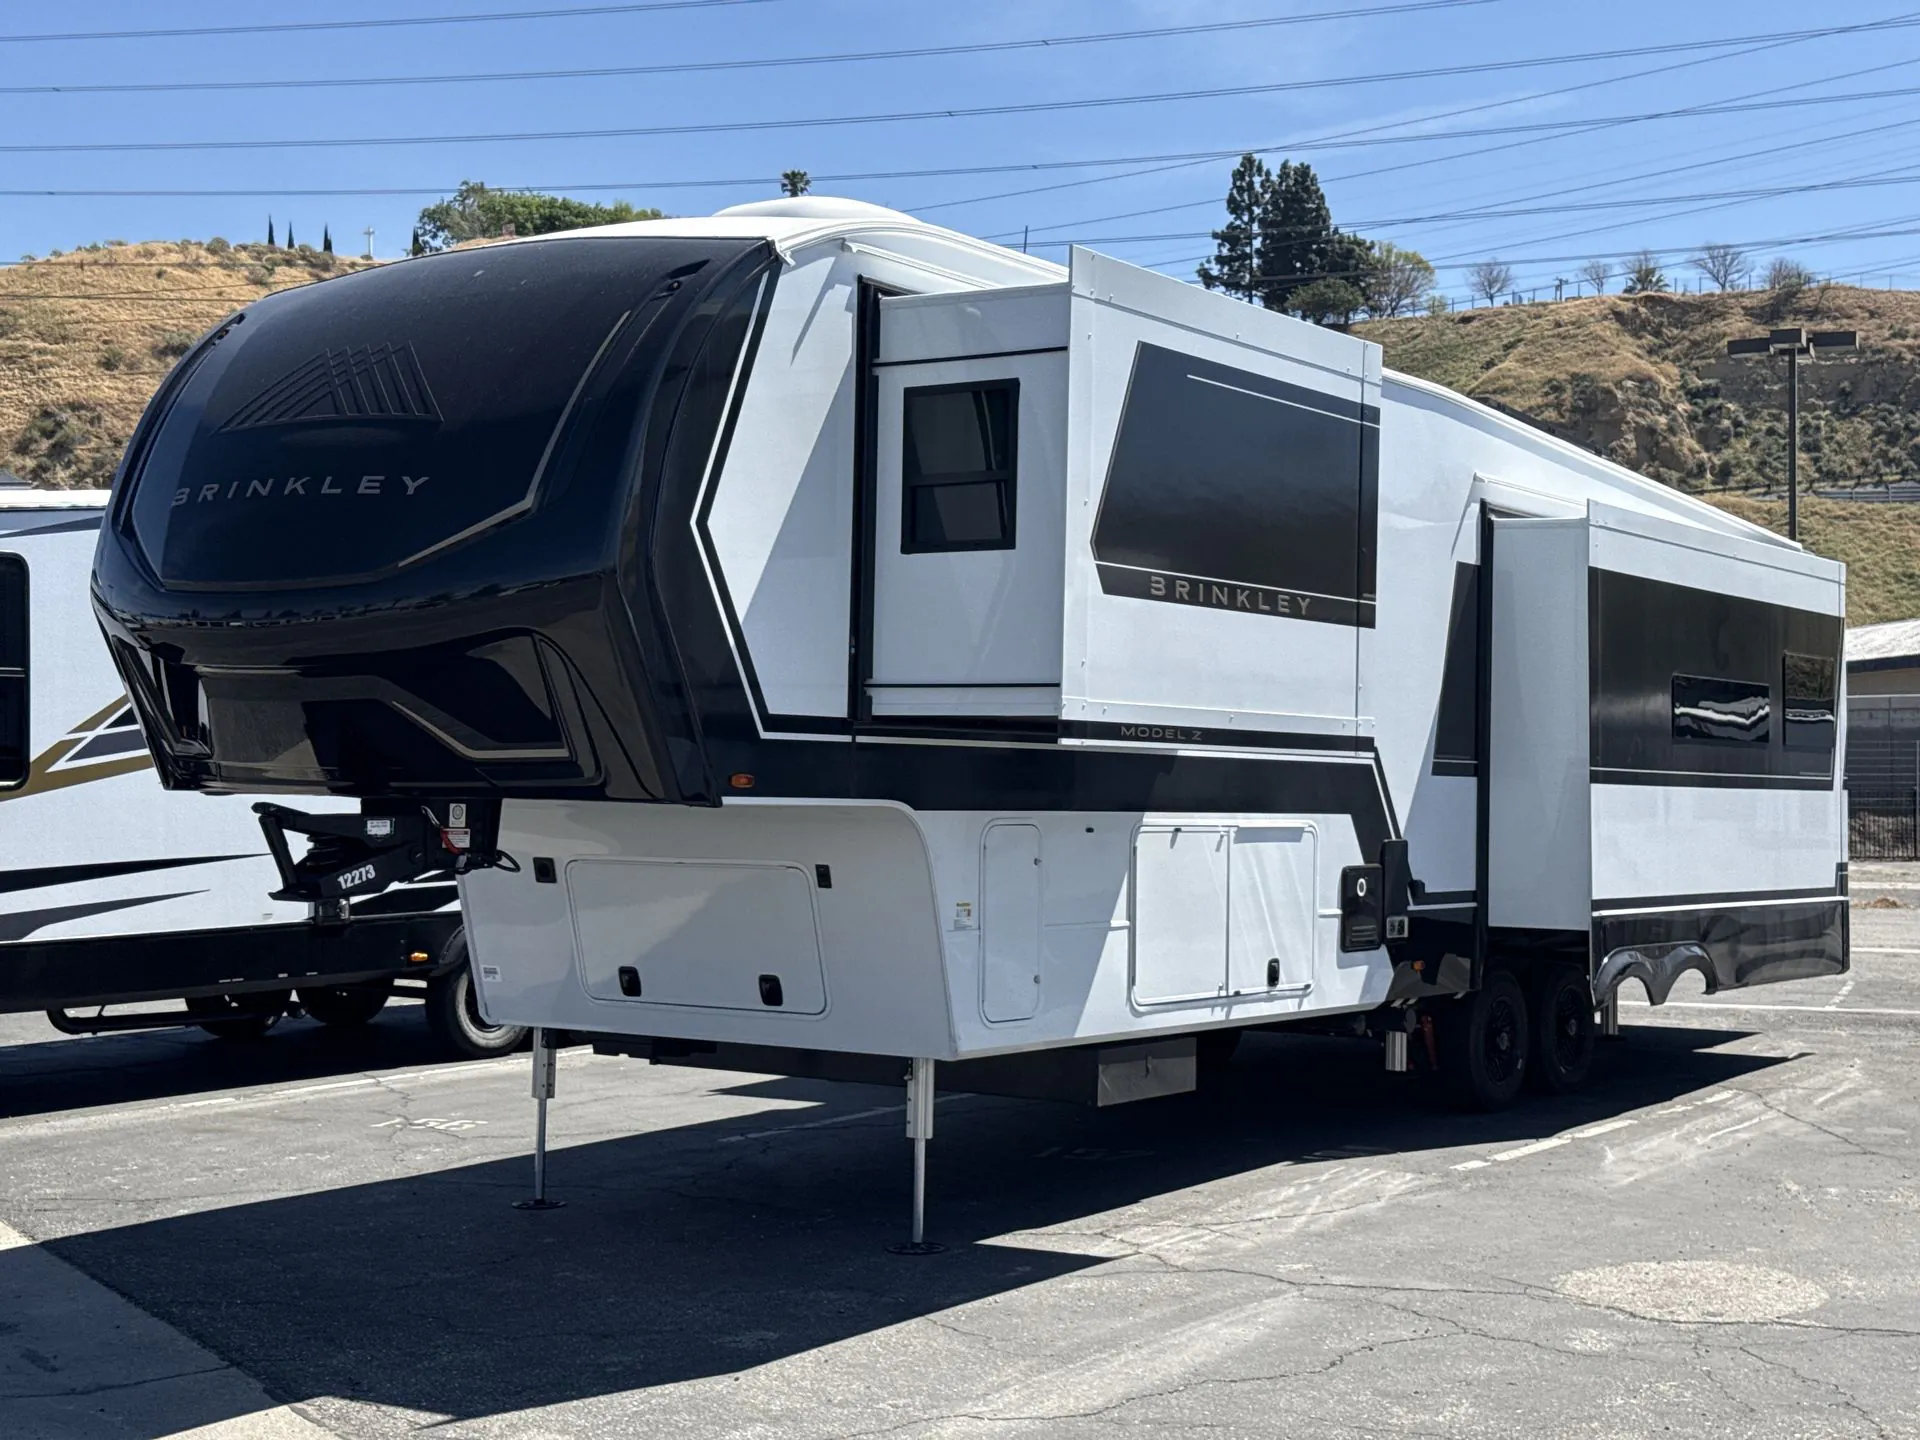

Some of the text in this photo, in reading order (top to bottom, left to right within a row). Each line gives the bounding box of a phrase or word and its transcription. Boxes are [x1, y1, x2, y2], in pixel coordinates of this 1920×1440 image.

[171, 475, 430, 506] BRINKLEY
[1150, 575, 1311, 616] BRINKLEY
[1120, 725, 1202, 741] MODEL Z
[337, 864, 376, 890] 12273
